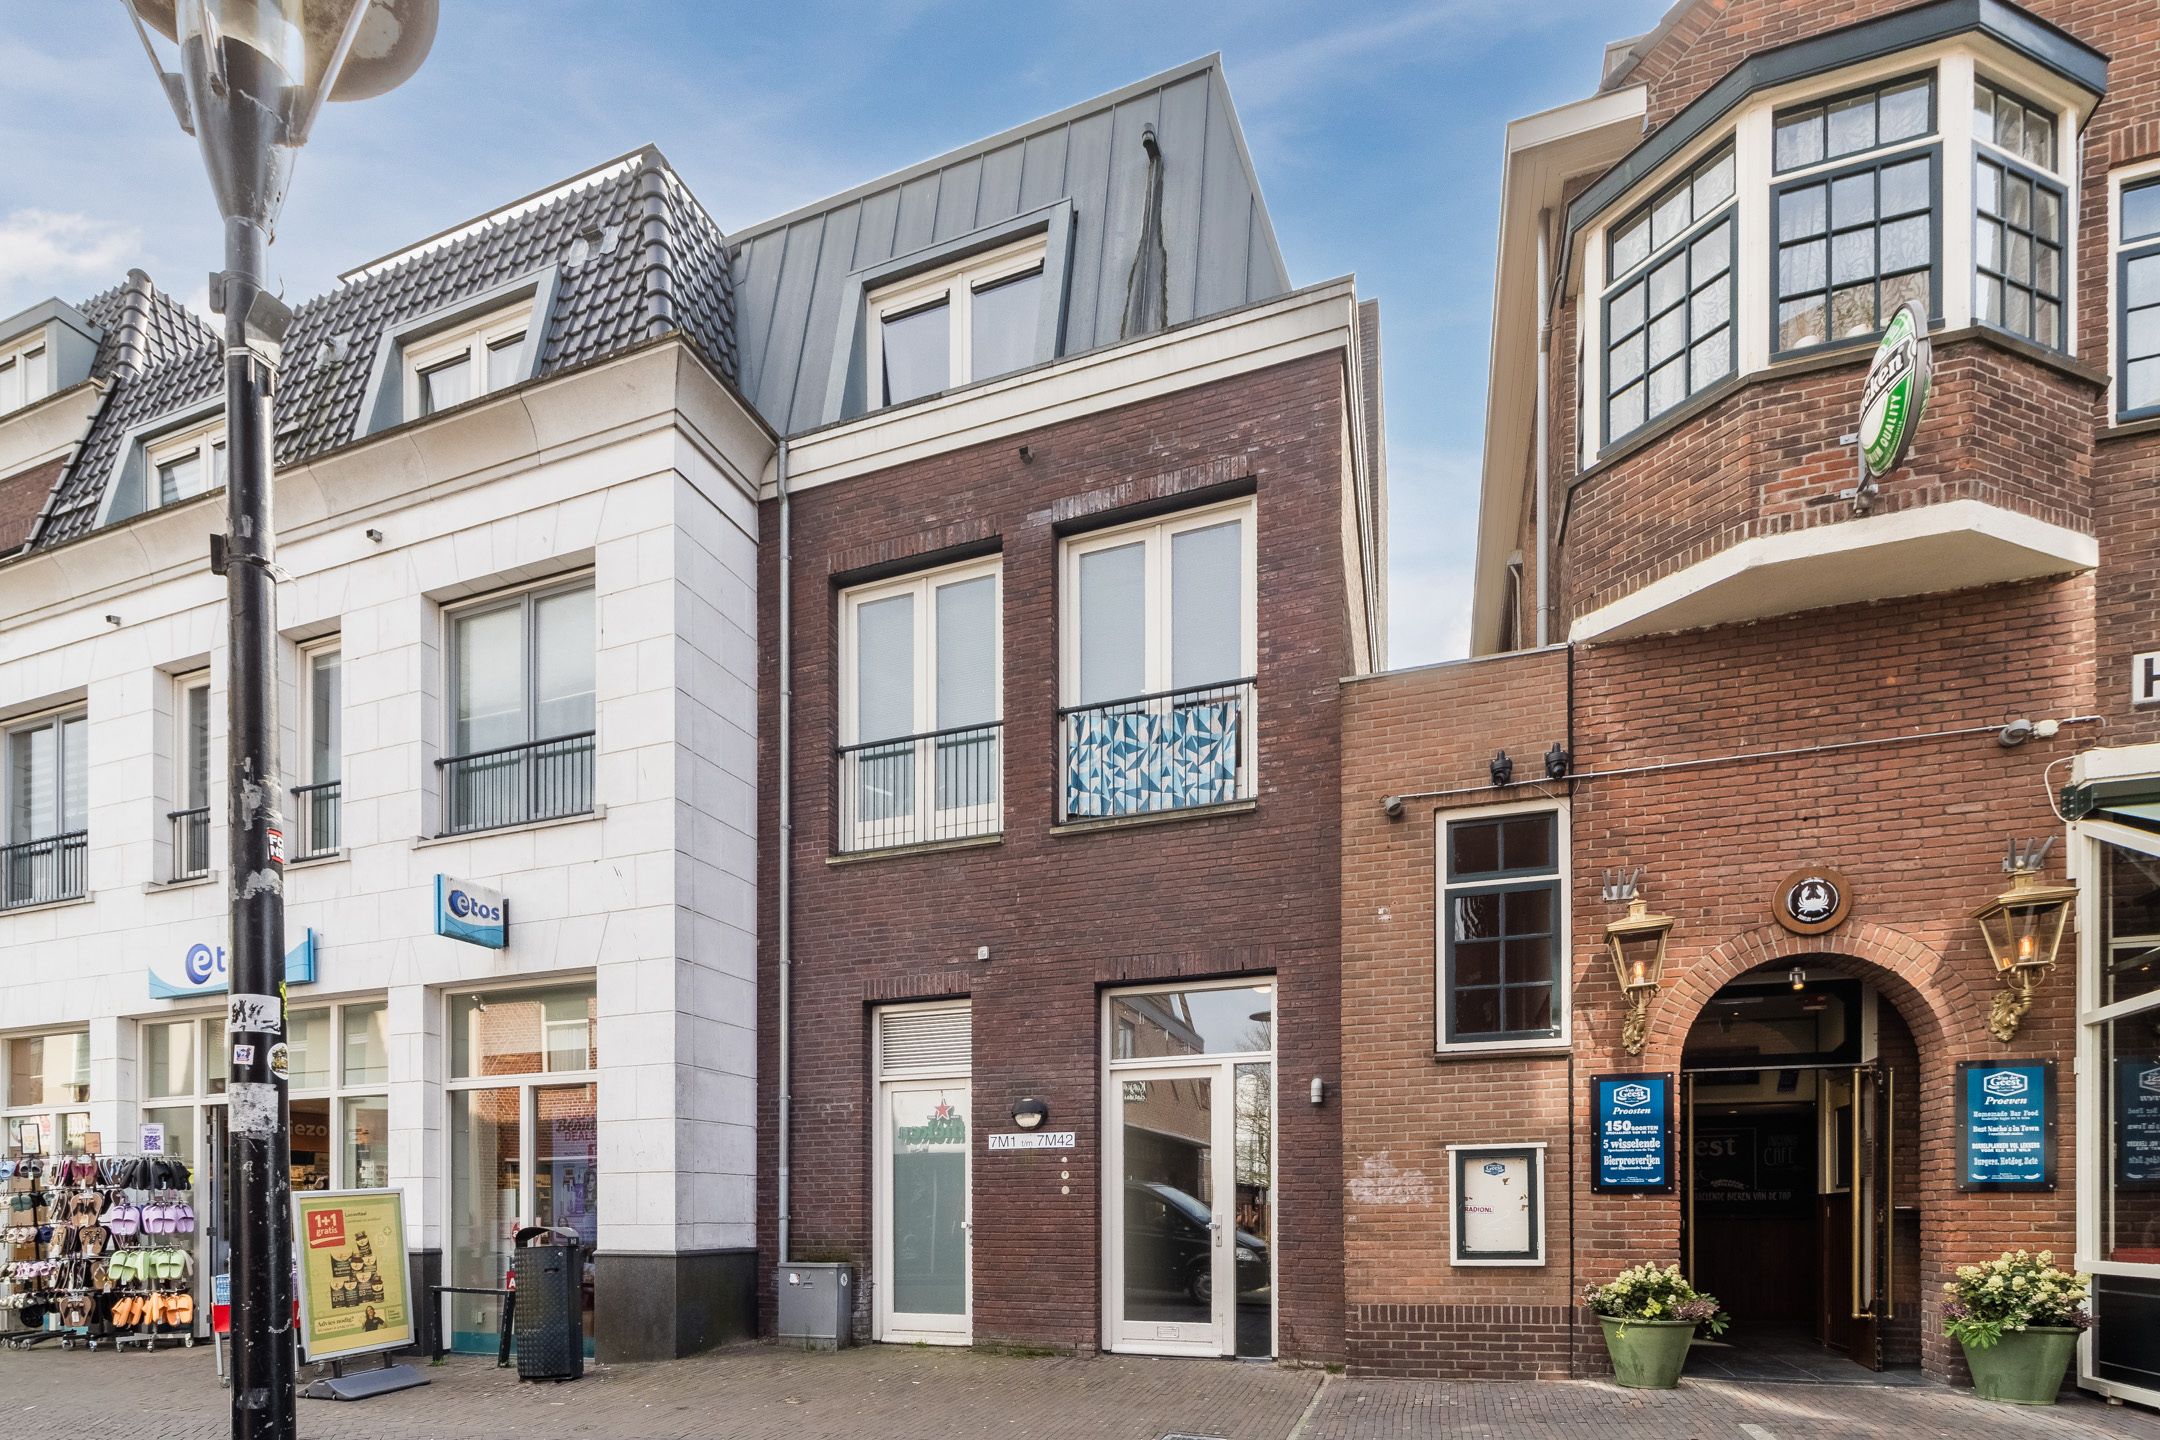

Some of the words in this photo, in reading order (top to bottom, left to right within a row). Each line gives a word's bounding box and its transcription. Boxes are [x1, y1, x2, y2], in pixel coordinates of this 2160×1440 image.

[1880, 394, 1901, 448] QUALITY
[447, 889, 500, 921] etos
[185, 943, 226, 985] et
[1990, 1078, 2021, 1087] Geest
[1619, 1089, 1645, 1098] Geest
[1984, 1096, 2027, 1105] Proeven
[1612, 1107, 1651, 1115] Proosten
[294, 1123, 328, 1137] ezo
[1605, 1120, 1632, 1131] 150
[1973, 1125, 1987, 1133] Best
[990, 1136, 1016, 1148] 7M1
[1021, 1139, 1033, 1147] t/m
[1037, 1134, 1073, 1147] 7M42
[1603, 1139, 1609, 1149] 5
[1610, 1137, 1661, 1149] wisselende
[1694, 1137, 1737, 1156] est
[1603, 1154, 1660, 1167] Bierproeverijen
[314, 1213, 337, 1228] 1+1
[316, 1226, 338, 1238] gratis
